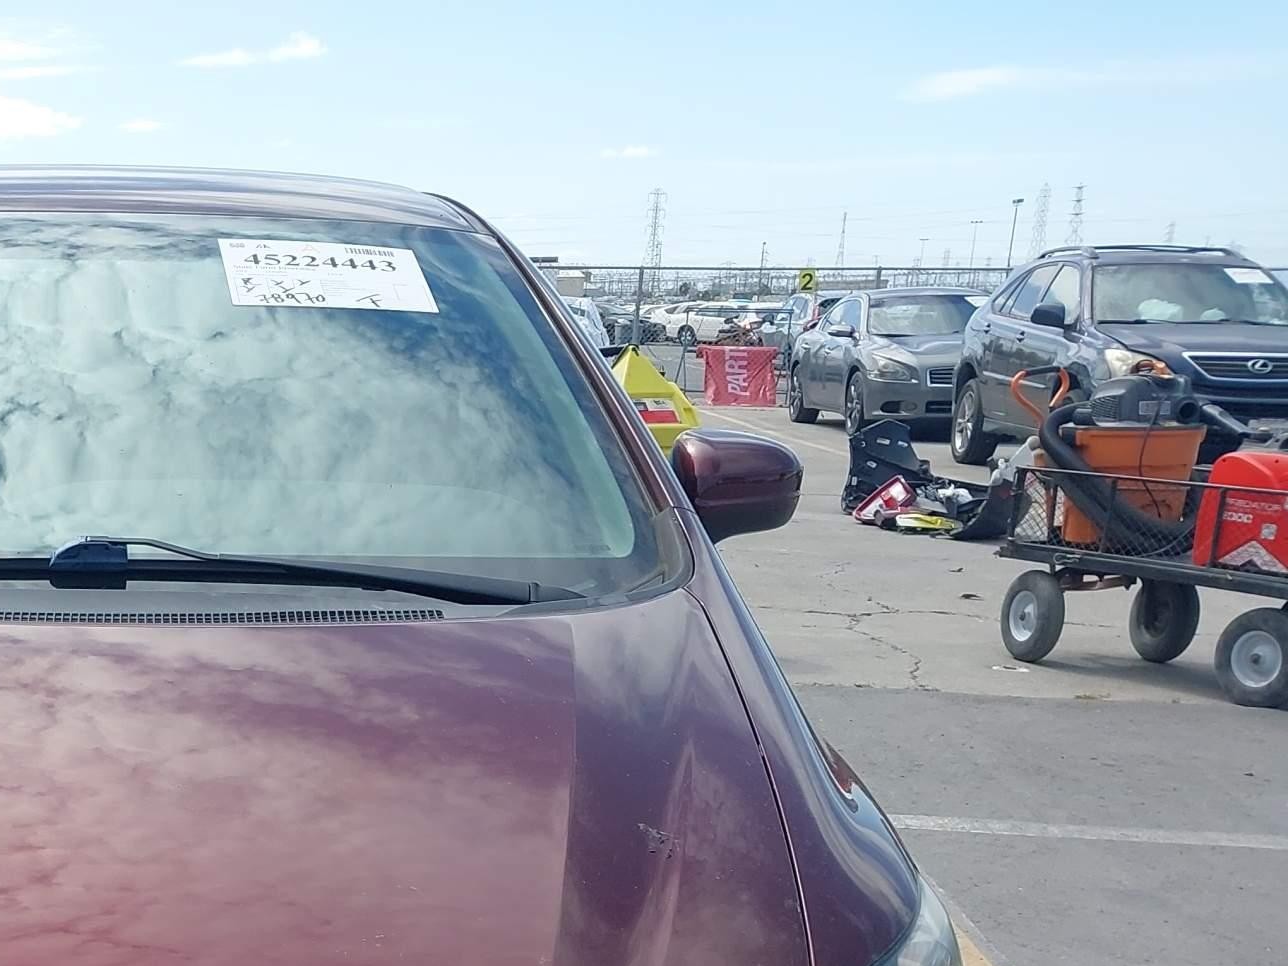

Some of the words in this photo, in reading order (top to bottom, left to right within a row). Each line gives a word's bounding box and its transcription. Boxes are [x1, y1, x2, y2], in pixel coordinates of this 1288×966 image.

[244, 253, 397, 273] 45224443
[801, 273, 813, 290] 2
[725, 347, 751, 396] PART
